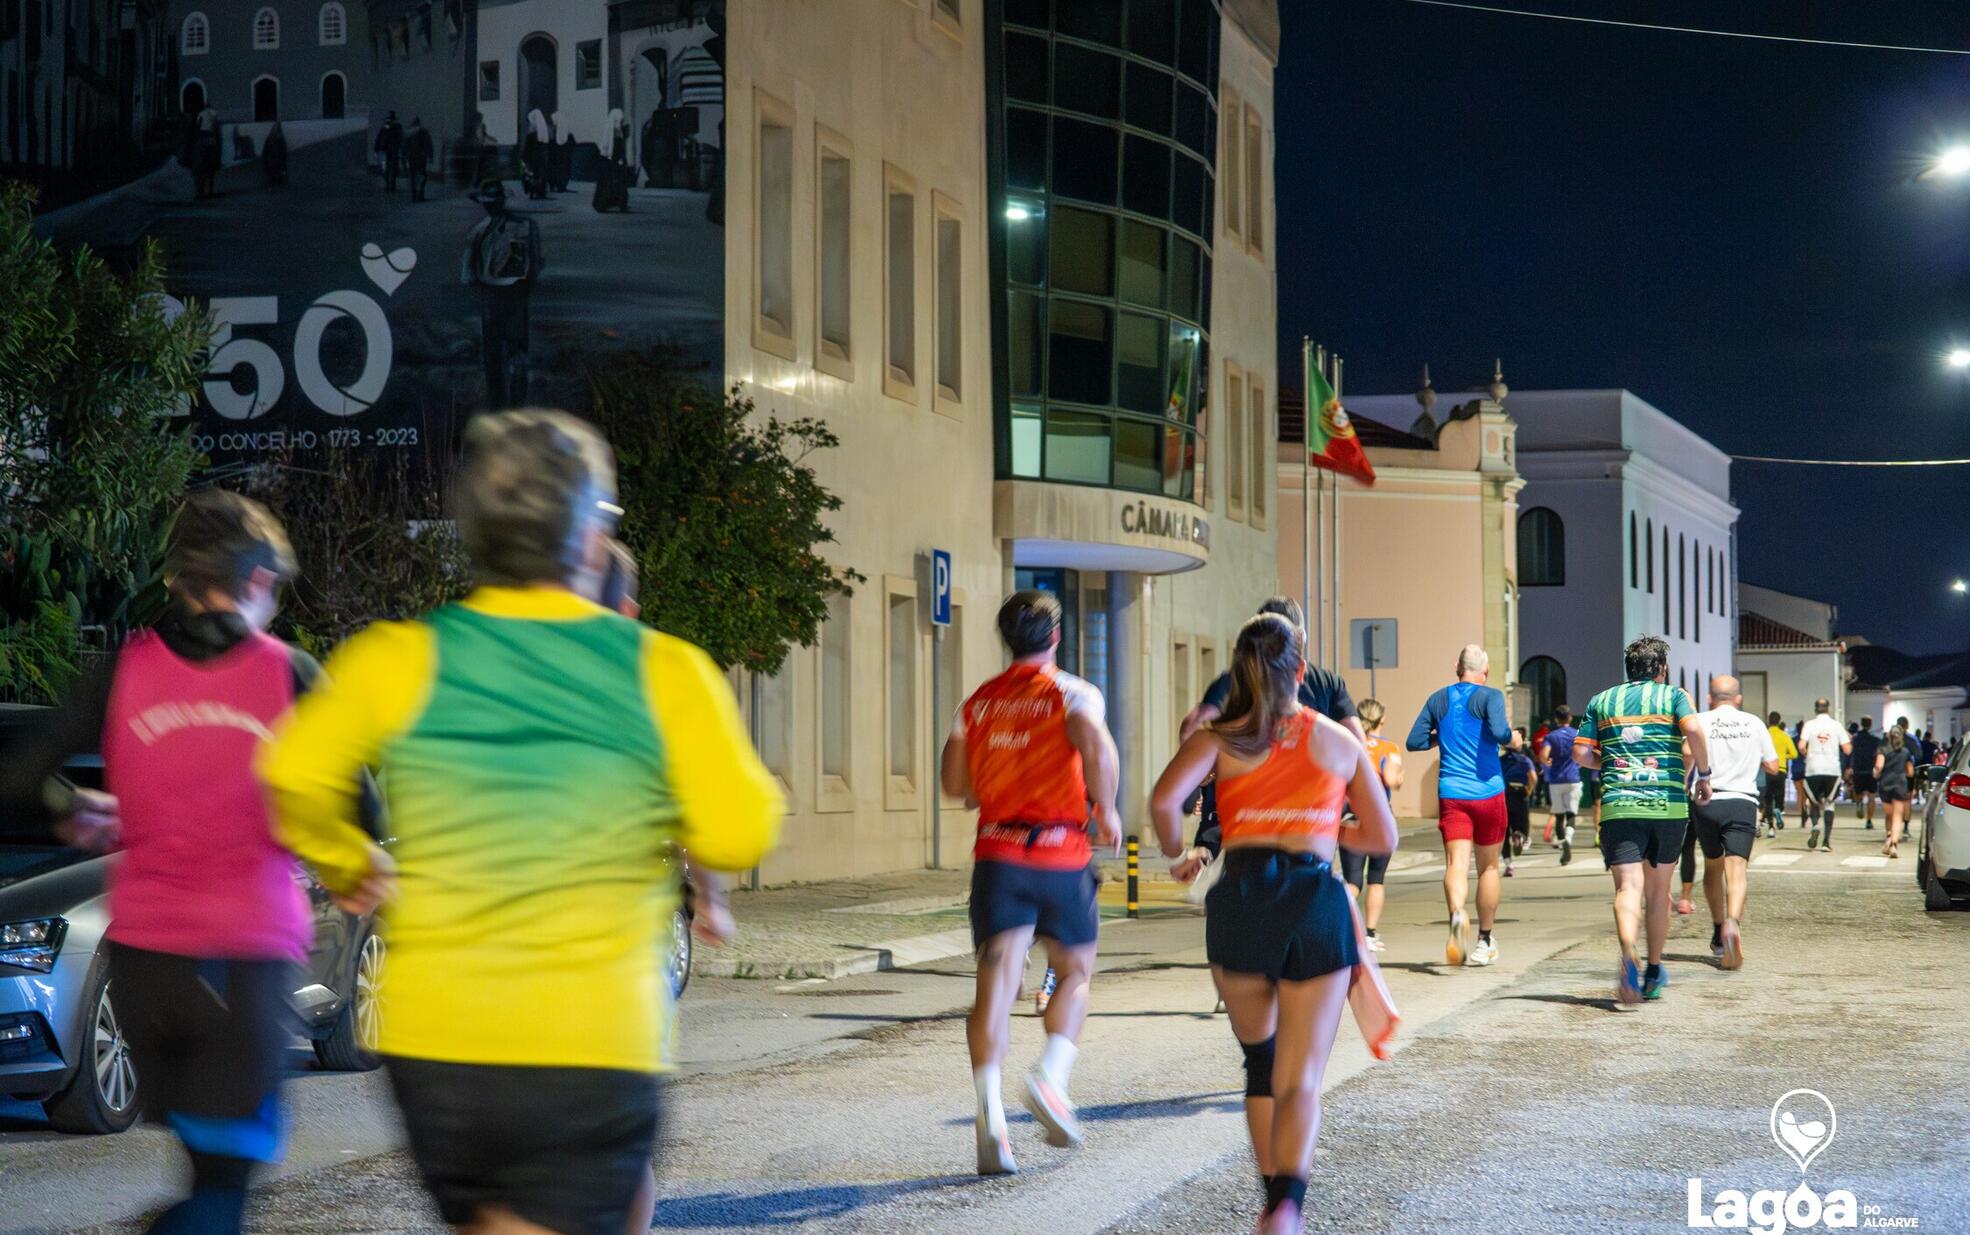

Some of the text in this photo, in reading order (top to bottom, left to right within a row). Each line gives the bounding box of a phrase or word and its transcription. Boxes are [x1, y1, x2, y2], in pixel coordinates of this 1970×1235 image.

[137, 290, 393, 420] 50
[218, 430, 317, 451] CONCELHO
[936, 556, 948, 615] P
